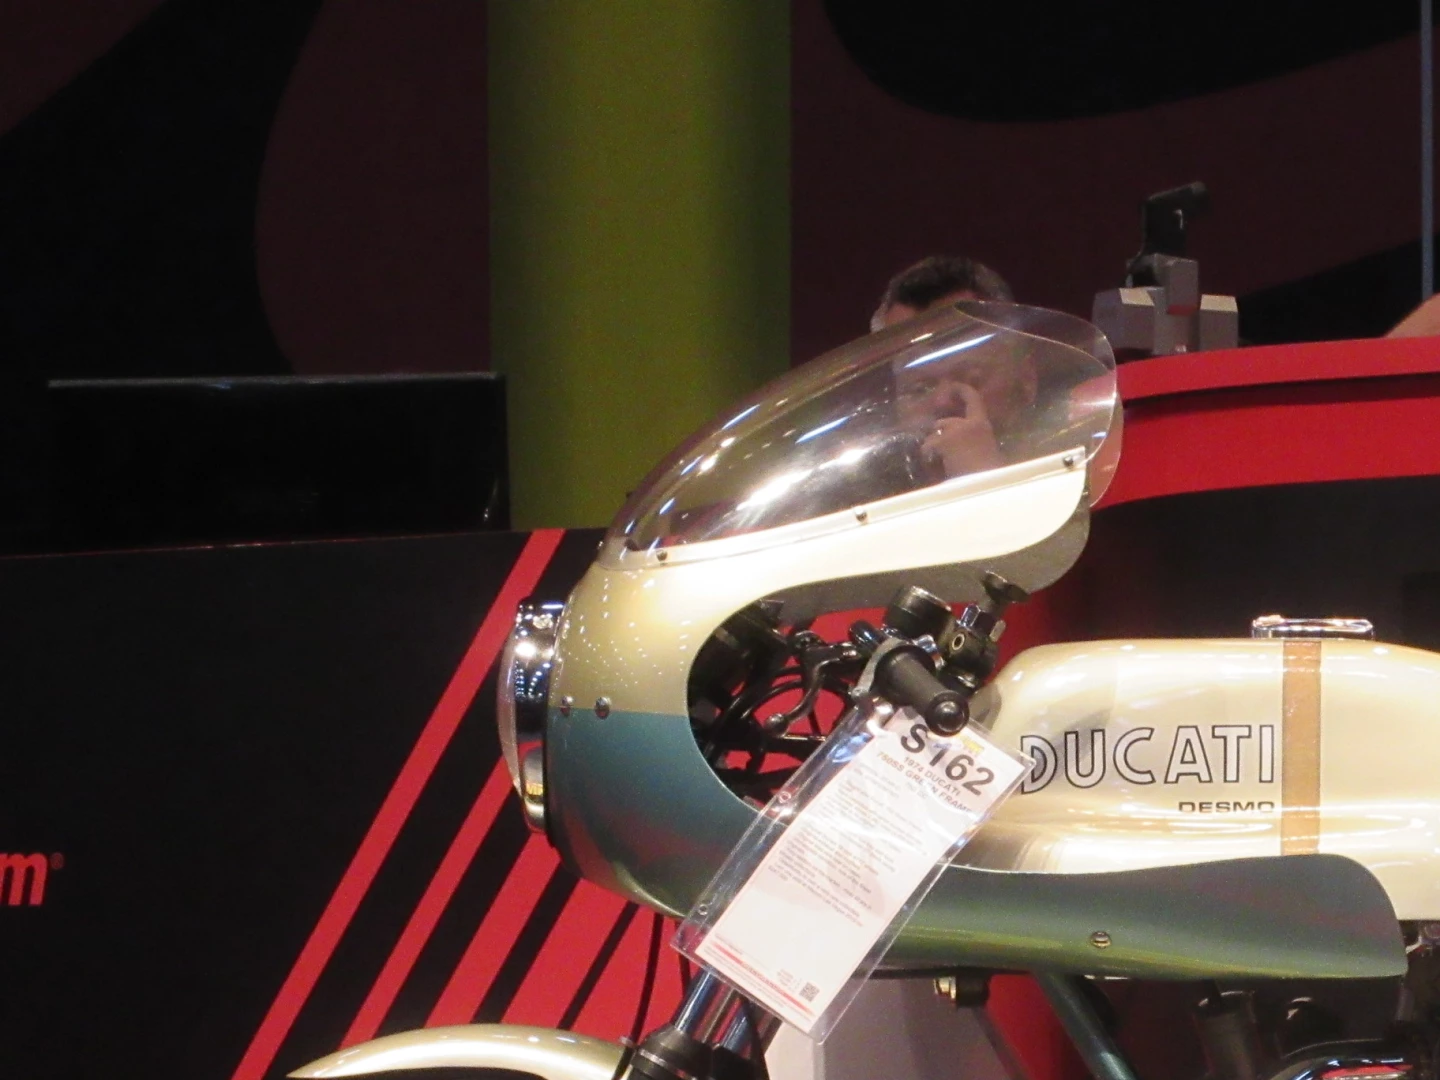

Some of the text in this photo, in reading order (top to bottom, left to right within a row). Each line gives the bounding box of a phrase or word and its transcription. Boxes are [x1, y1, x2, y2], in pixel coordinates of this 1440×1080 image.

[901, 724, 995, 796] S162
[1020, 724, 1275, 795] DUCATI
[1178, 801, 1275, 814] DESMO
